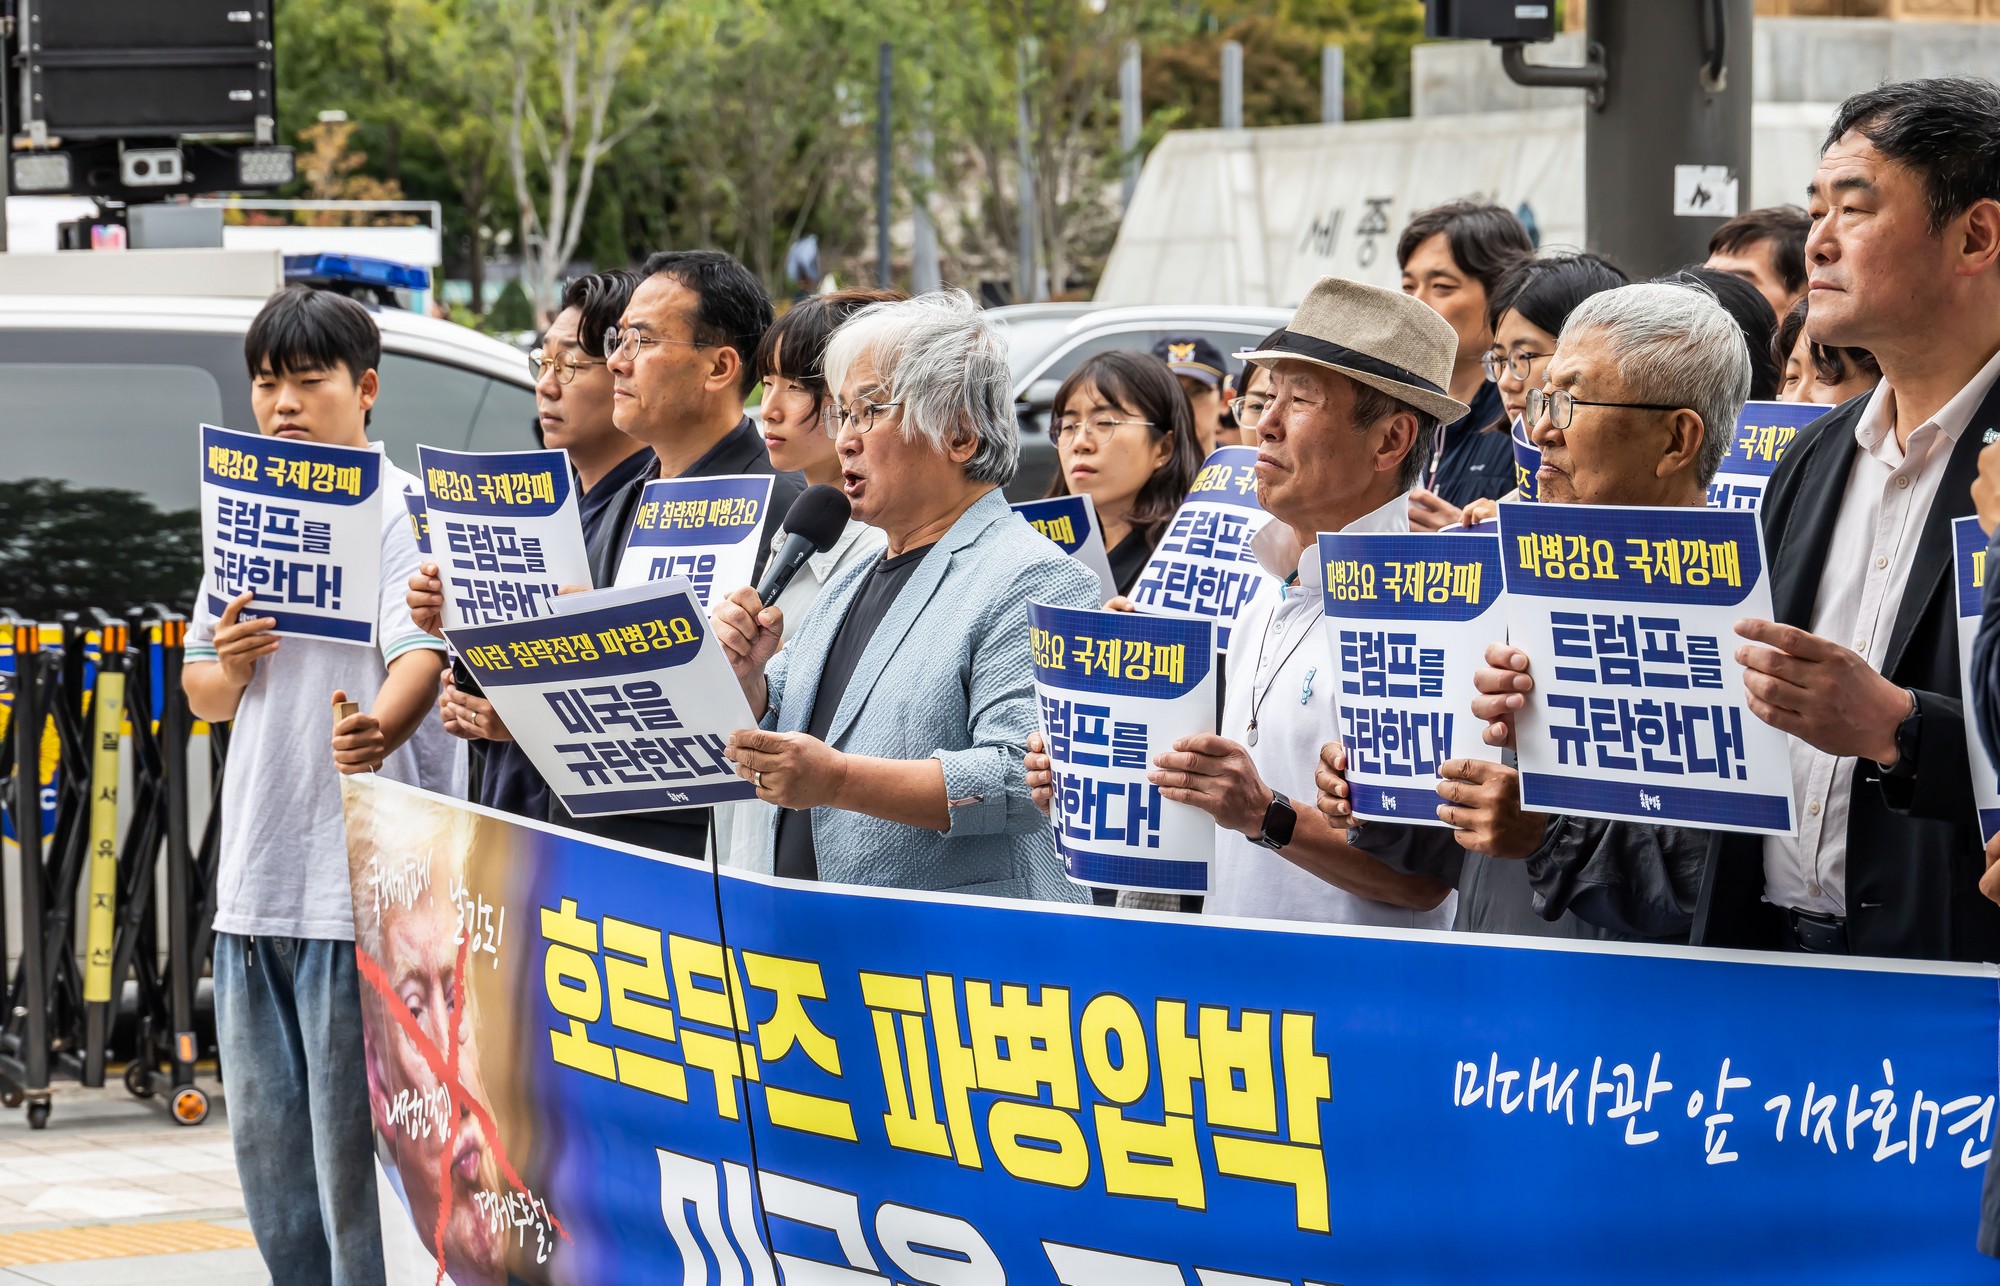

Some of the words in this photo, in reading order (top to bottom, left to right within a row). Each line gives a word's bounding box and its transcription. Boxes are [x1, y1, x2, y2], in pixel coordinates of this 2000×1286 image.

[1739, 425, 1799, 462] 국제깡
[208, 446, 258, 481] 파병강요
[264, 456, 361, 496] 국제깡패
[427, 467, 477, 501] 파병강요
[477, 471, 555, 504] 국제깡패
[217, 496, 331, 554] 트럼프를
[637, 502, 659, 529] 이란
[660, 499, 708, 529] 침략전쟁
[707, 497, 758, 527] 파병강요
[446, 522, 546, 573] 트럼프를
[1517, 532, 1619, 580] 파병강요
[1625, 538, 1742, 587] 국제깡패
[213, 546, 342, 610] 규탄한다!
[451, 577, 559, 625] 규탄한다
[1326, 559, 1378, 601] 파병강요
[1382, 560, 1483, 604] 국제깡패
[465, 643, 513, 671] 이란
[513, 633, 600, 668] 침략전쟁
[596, 617, 699, 657] 파병강요
[1071, 635, 1185, 684] 국제깡패
[1339, 630, 1445, 699] 트럼프를
[1550, 610, 1723, 690] 트럼프를
[542, 680, 684, 734] 미국을
[1547, 693, 1748, 781] 규탄한다!
[449, 874, 505, 970] 날강도!
[539, 896, 860, 1144] 호르무즈
[858, 968, 1332, 1236] 파병압박
[1453, 1051, 1673, 1145] 미대사관
[1686, 1057, 1751, 1165] 앞
[1764, 1058, 1996, 1169] 기자회견
